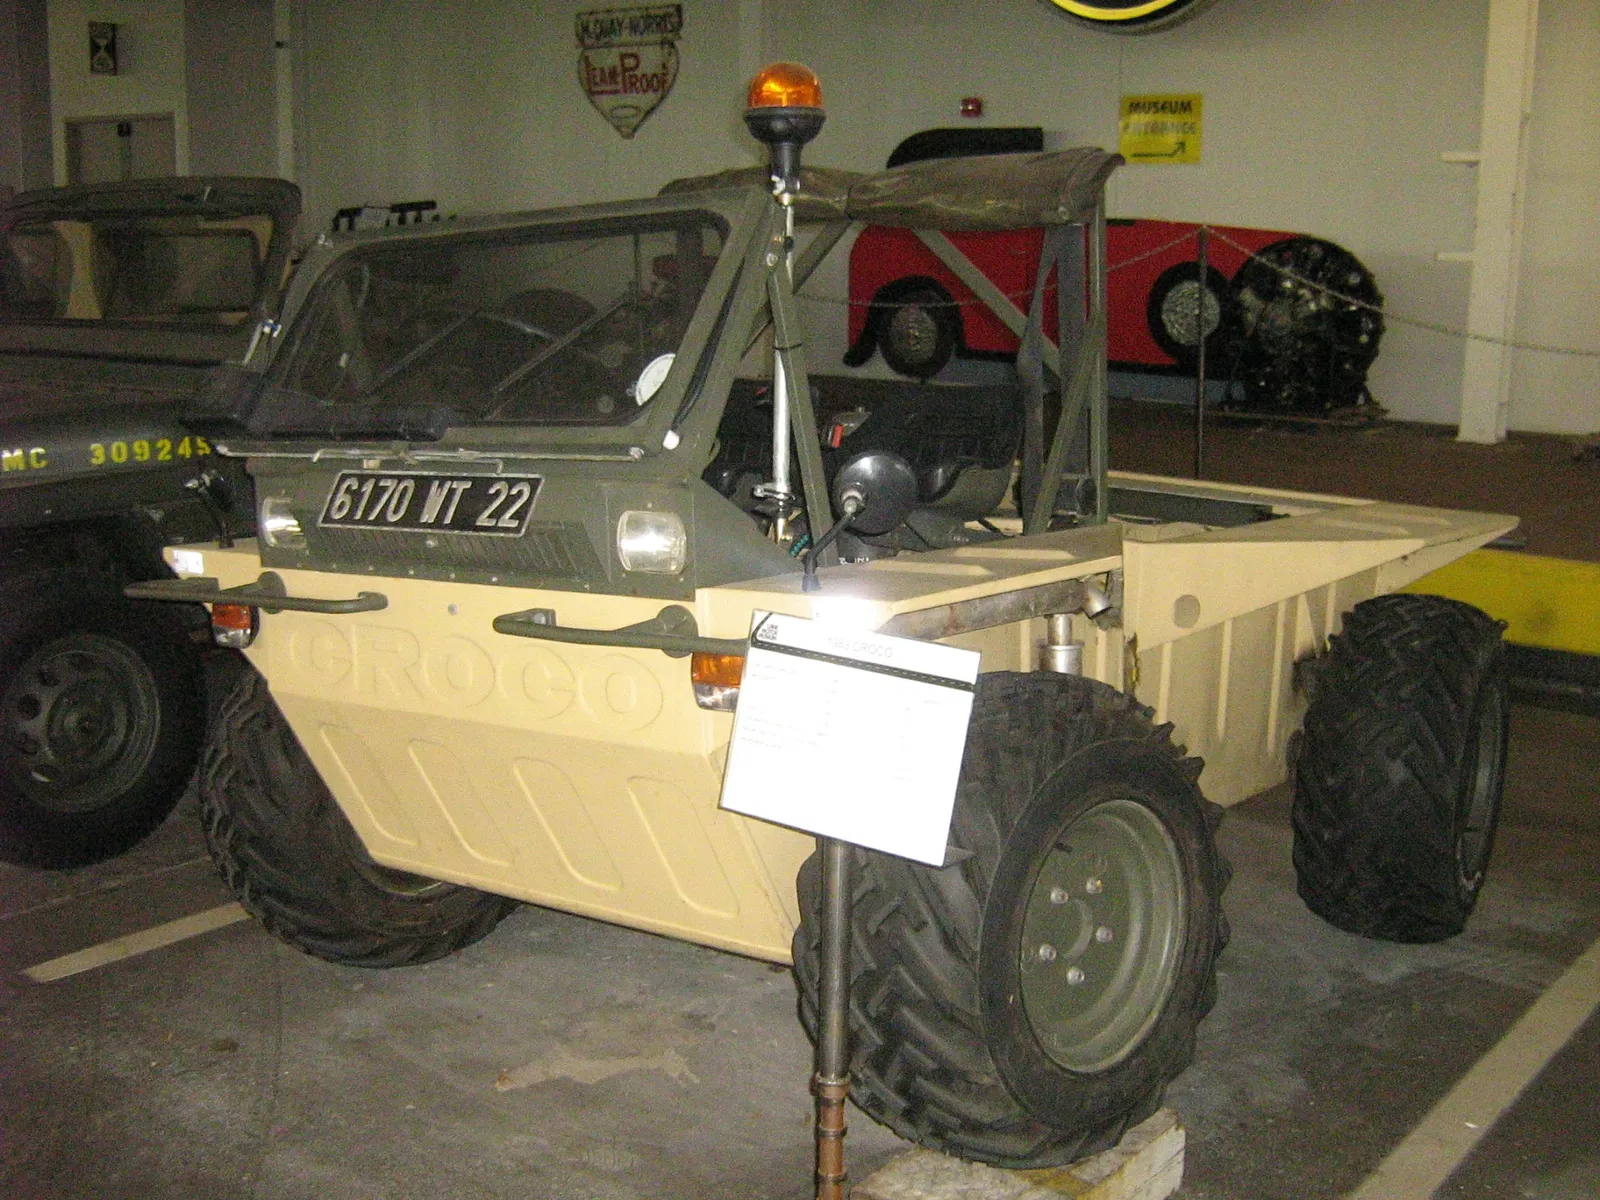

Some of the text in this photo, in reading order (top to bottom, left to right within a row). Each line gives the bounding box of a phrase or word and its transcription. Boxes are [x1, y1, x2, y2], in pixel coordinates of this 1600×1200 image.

[1128, 100, 1192, 114] MUSEUM
[89, 435, 212, 465] 309245
[329, 477, 531, 527] 6170 WT 22
[852, 640, 894, 658] CROCO
[290, 618, 664, 732] CROCO
